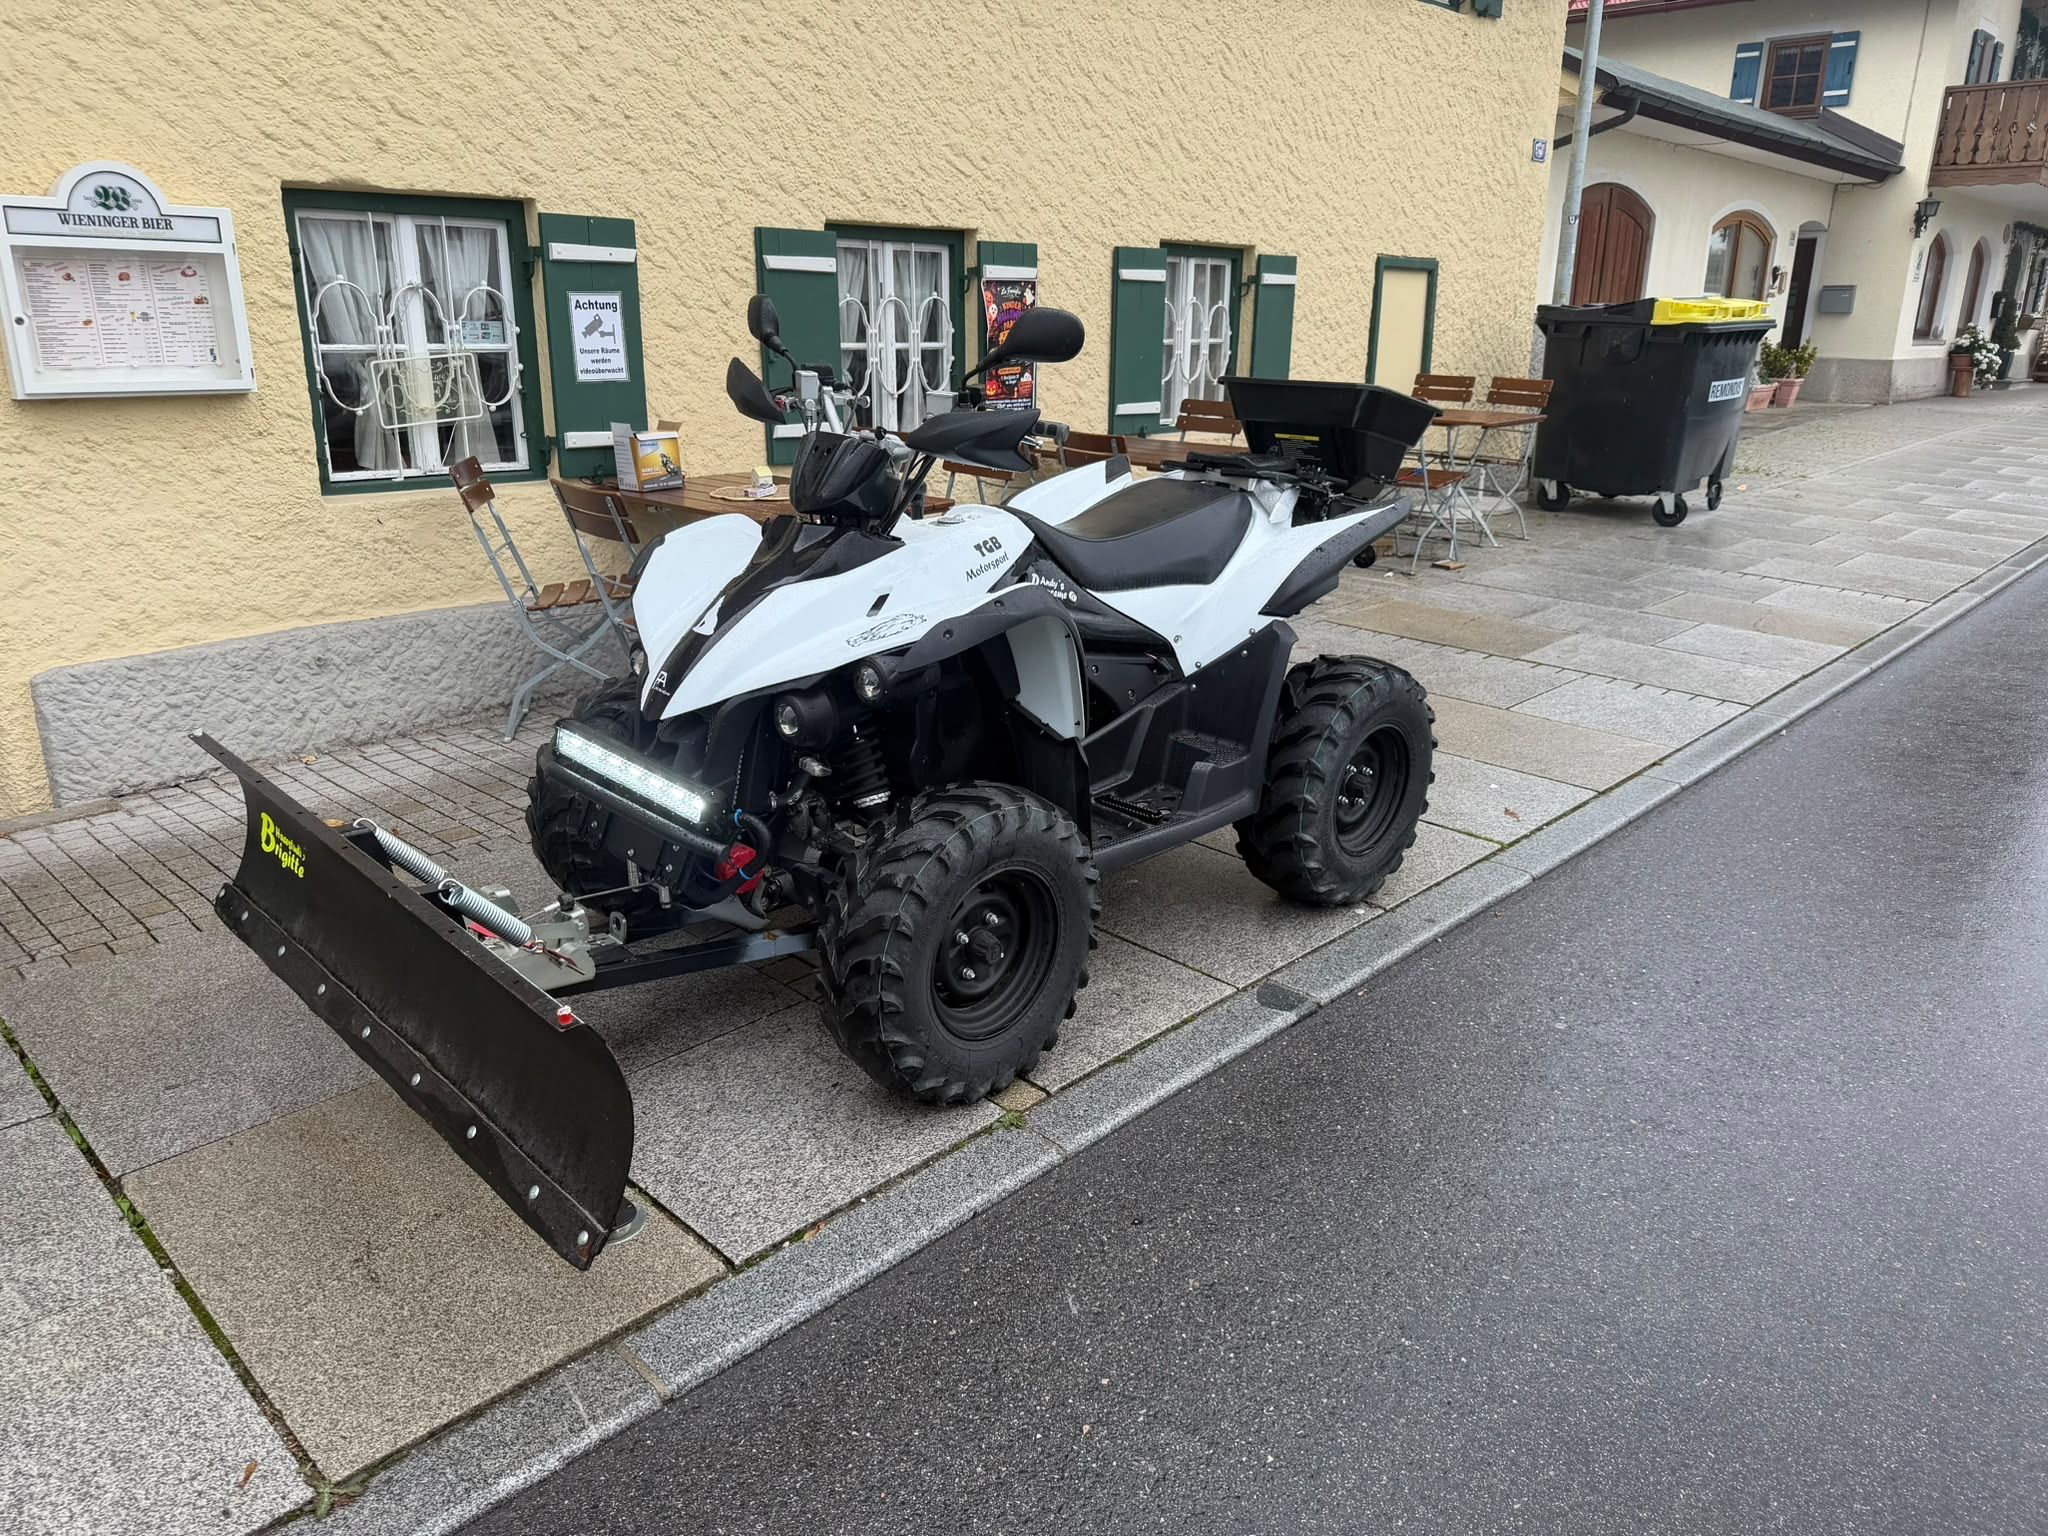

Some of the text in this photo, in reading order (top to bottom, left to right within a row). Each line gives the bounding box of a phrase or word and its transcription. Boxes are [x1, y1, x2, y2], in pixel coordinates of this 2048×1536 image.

[57, 213, 174, 231] WIENINGER BIER
[574, 299, 618, 312] Achtung
[579, 367, 624, 375] videoüberwacht
[973, 536, 1002, 557] TGB
[966, 551, 1009, 582] Motorsport
